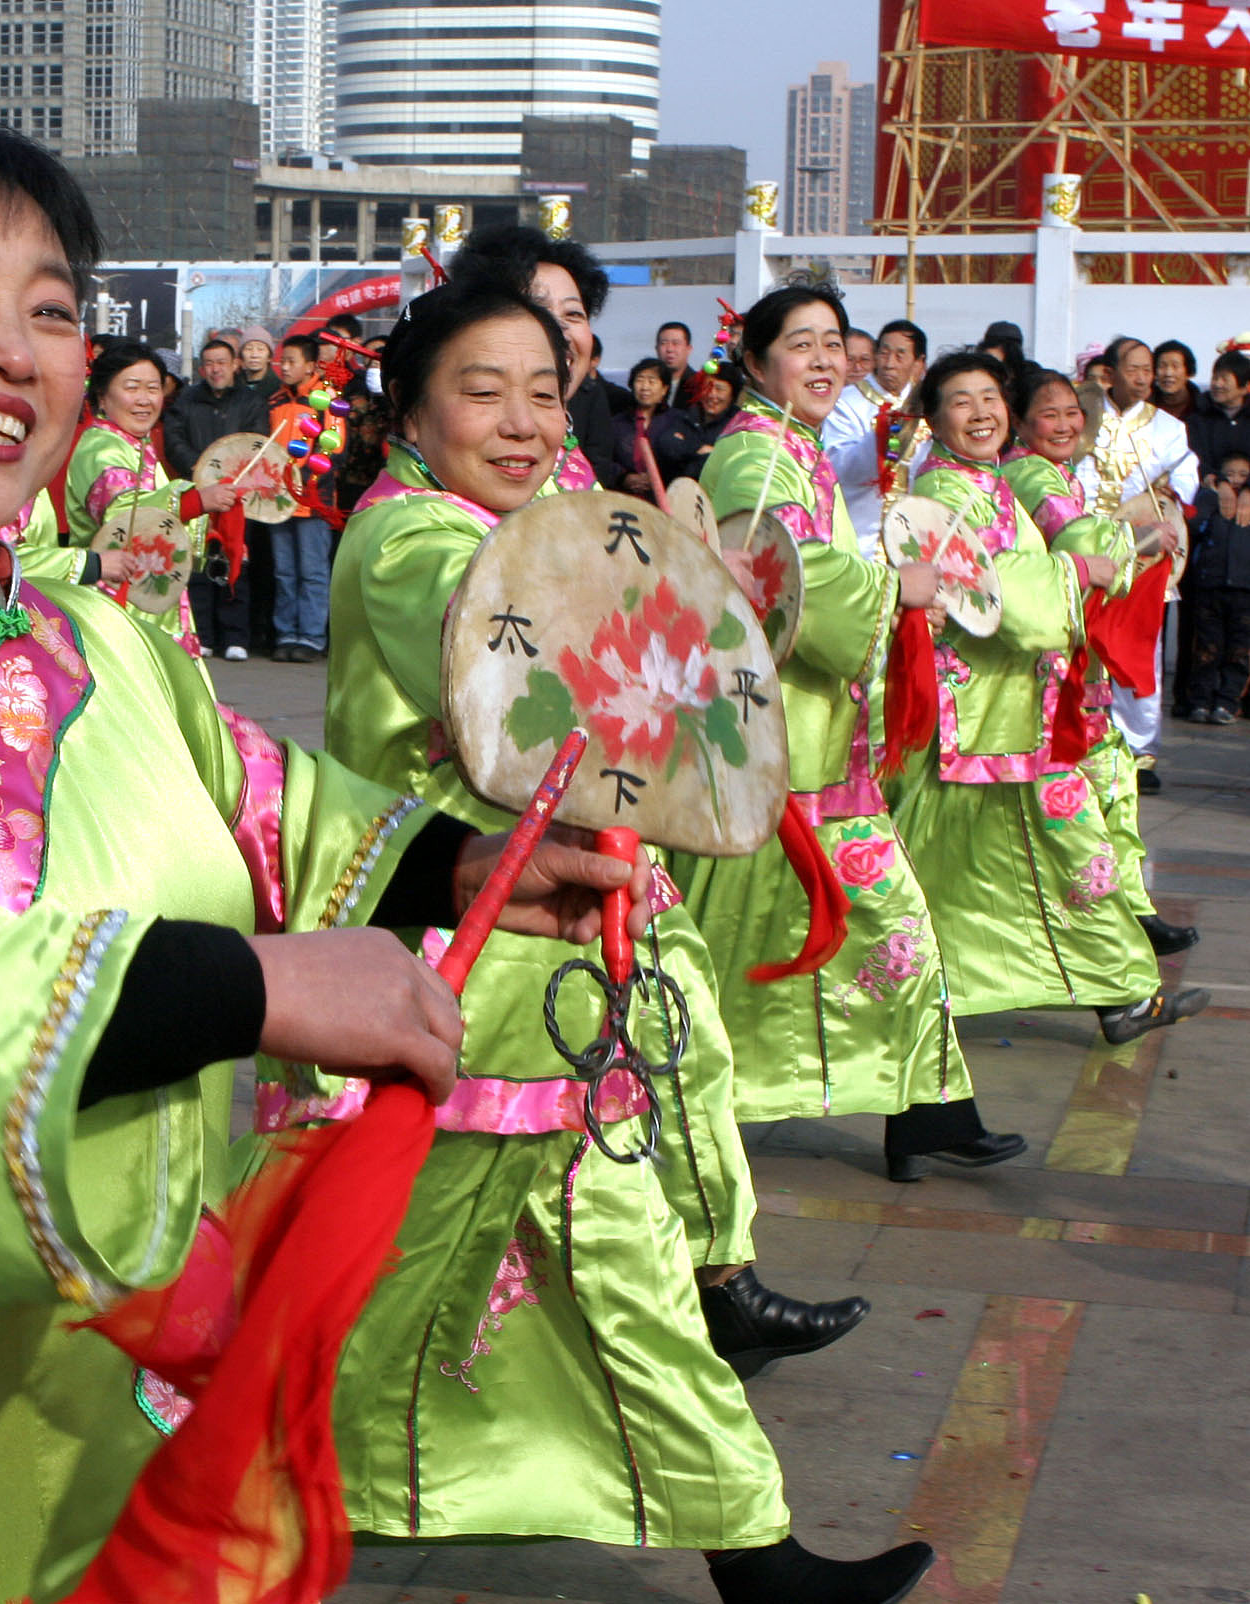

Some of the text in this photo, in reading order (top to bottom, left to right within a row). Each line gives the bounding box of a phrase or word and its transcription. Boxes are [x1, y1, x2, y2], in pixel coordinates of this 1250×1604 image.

[605, 511, 651, 565] 天
[487, 604, 539, 658] 太
[727, 668, 769, 724] 平
[599, 767, 647, 814] 下
